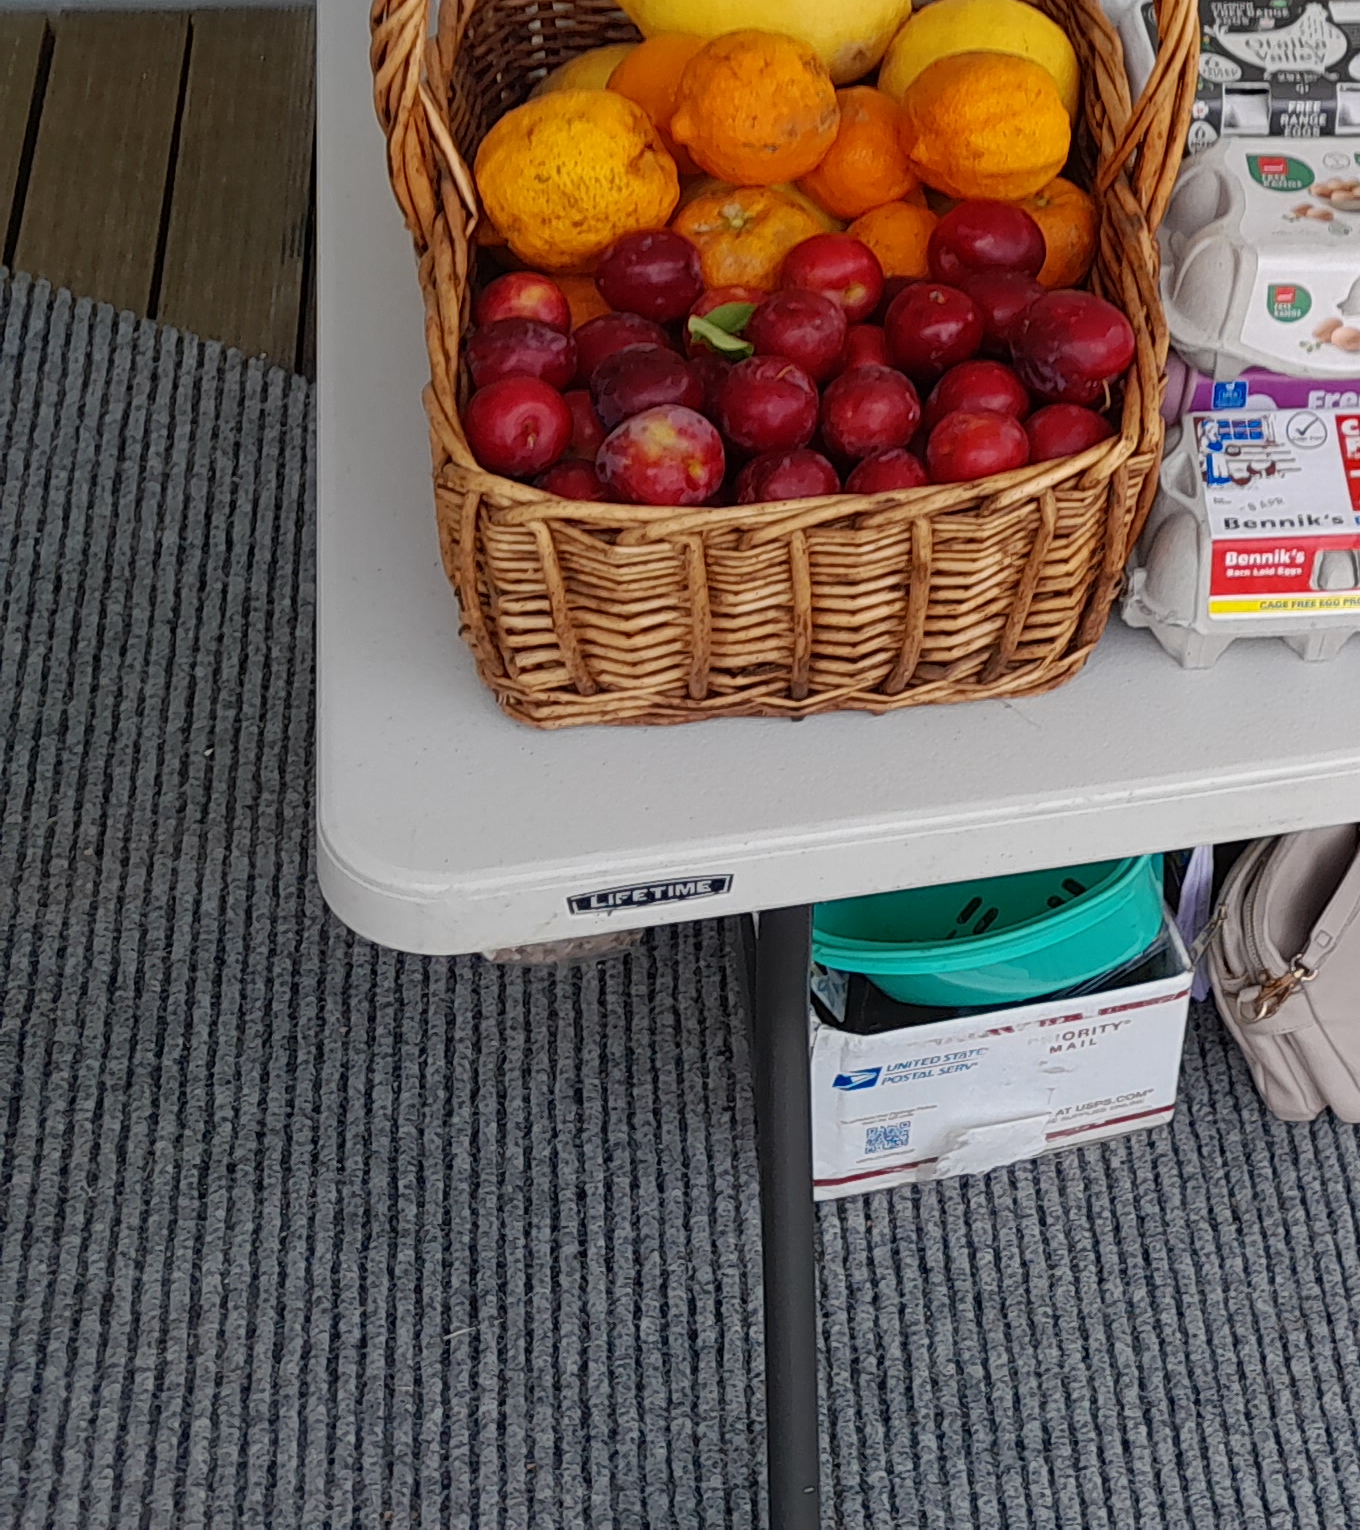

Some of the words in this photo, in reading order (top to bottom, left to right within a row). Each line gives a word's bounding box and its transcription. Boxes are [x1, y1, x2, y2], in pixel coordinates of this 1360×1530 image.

[1256, 49, 1326, 66] Valley
[1287, 101, 1322, 112] FREE
[1280, 113, 1328, 126] RANGE
[1224, 514, 1344, 530] Bennik's
[1225, 548, 1305, 566] Bennik's
[1259, 600, 1288, 610] CAGE
[1291, 599, 1316, 609] FREE
[1319, 598, 1340, 608] EGG
[590, 880, 712, 909] LIFETIME
[1049, 1038, 1098, 1054] MAIL
[886, 1055, 941, 1072] UNITED
[881, 1069, 935, 1086] POSTAL
[1055, 1106, 1072, 1117] AT
